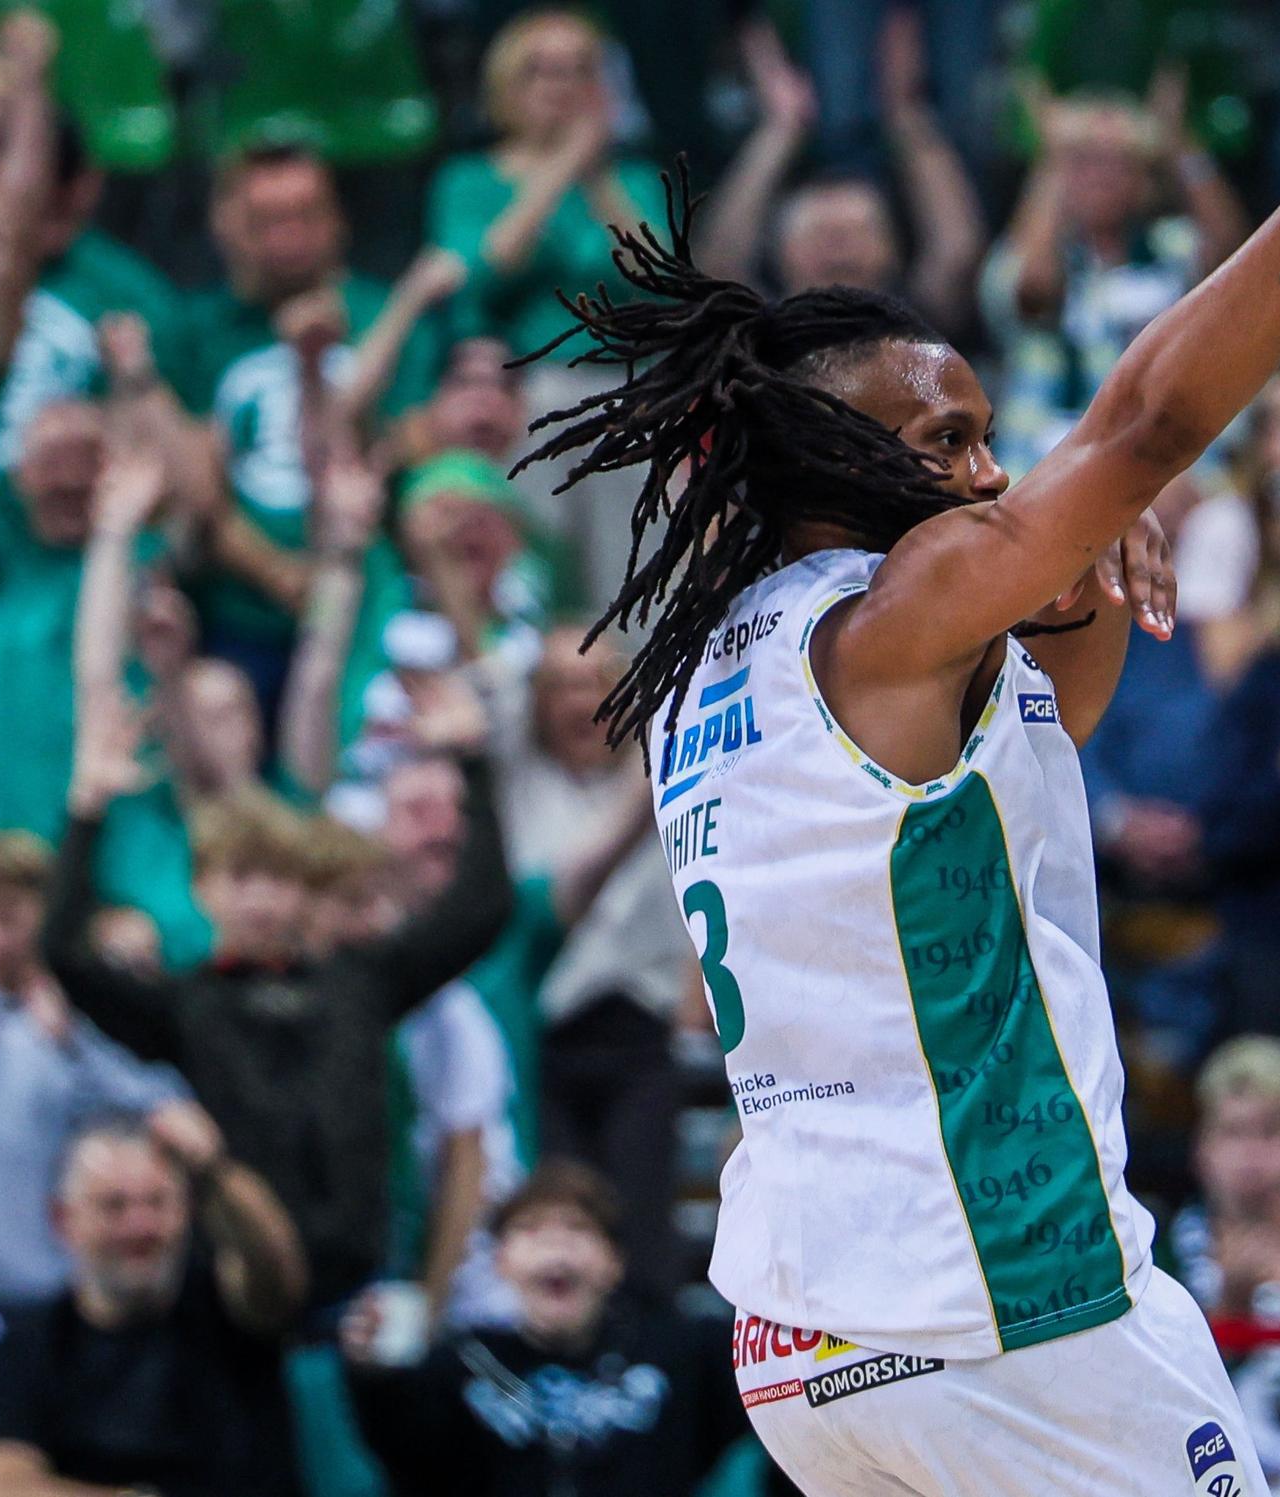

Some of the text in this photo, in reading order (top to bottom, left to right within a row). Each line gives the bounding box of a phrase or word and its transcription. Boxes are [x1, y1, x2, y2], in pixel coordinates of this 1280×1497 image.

[1024, 699, 1054, 718] PGE
[661, 797, 722, 875] WHITE
[937, 856, 1010, 901] 1946
[910, 919, 996, 978] 1946
[965, 972, 1034, 1027] 196
[741, 1081, 856, 1116] Ekonomiczna
[981, 1091, 1075, 1138] 1946
[961, 1151, 1053, 1209] 1946
[1021, 1212, 1109, 1257] 1946
[1194, 1432, 1226, 1465] PGE
